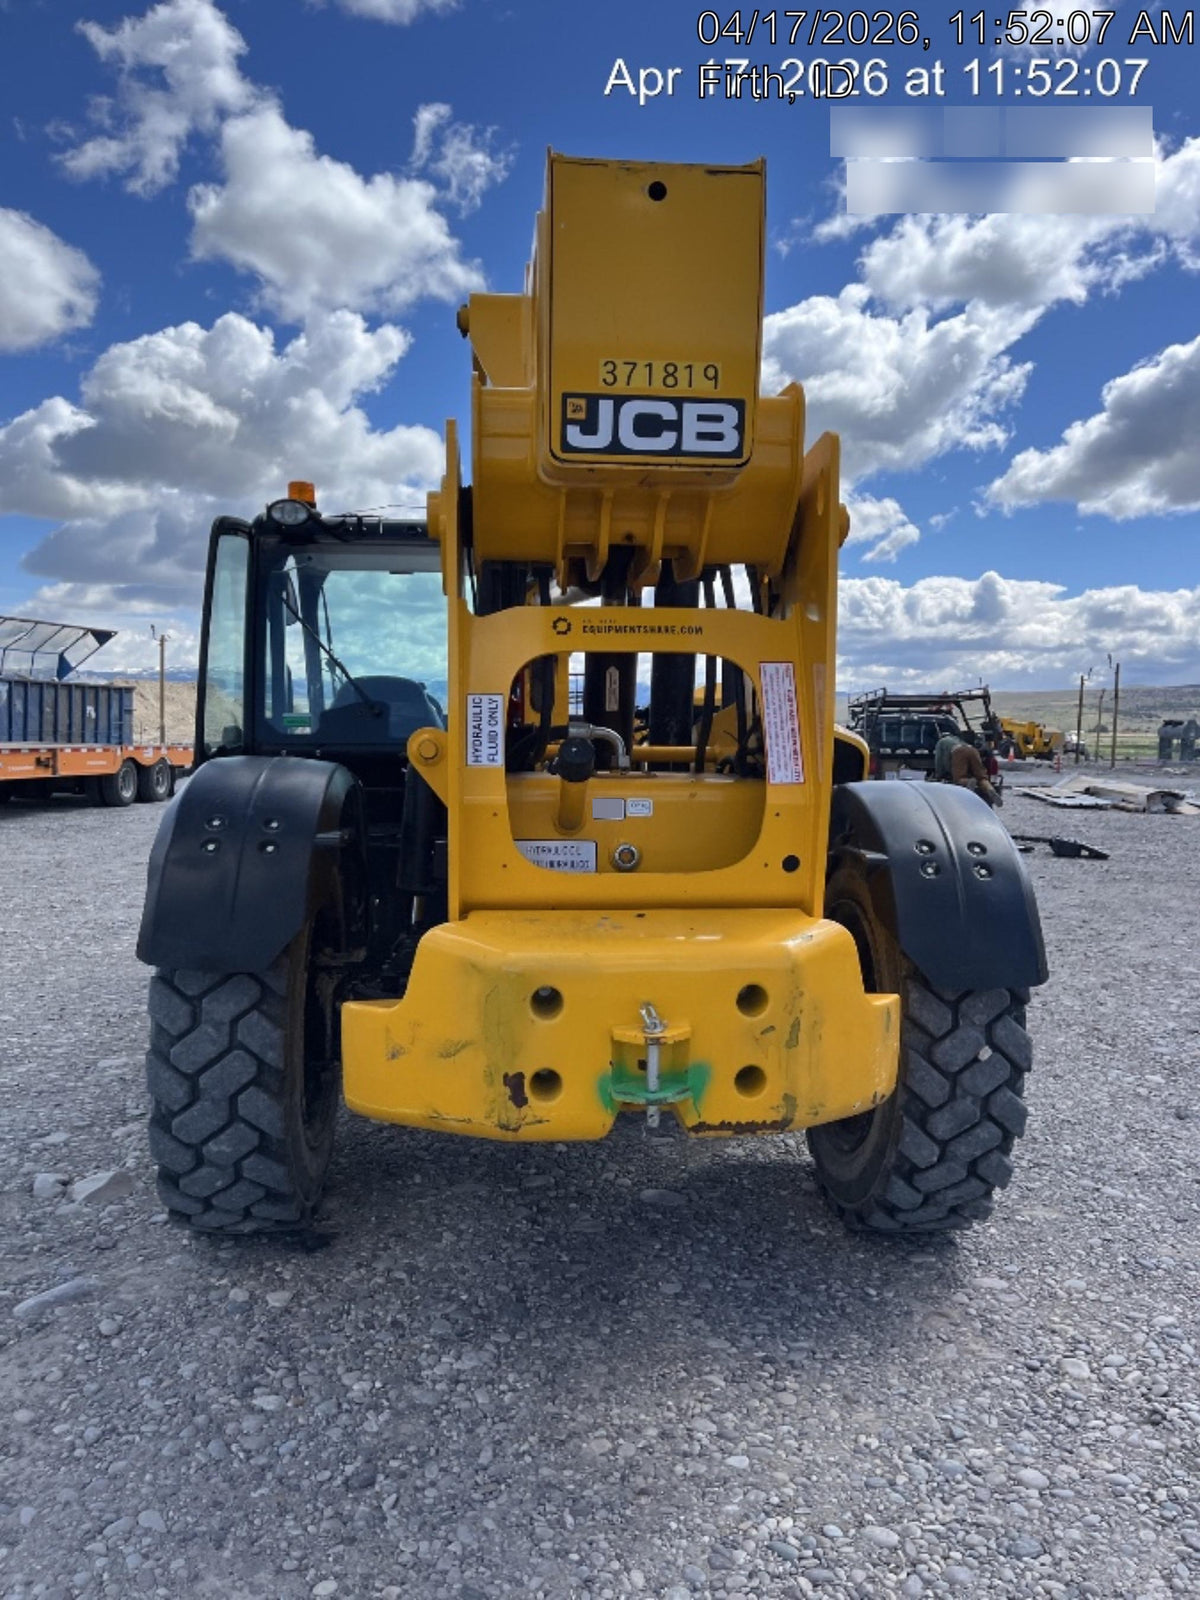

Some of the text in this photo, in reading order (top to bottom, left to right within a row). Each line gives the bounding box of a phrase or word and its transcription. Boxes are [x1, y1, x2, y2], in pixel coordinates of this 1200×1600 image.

[602, 360, 720, 390] 371819
[566, 399, 741, 452] JCB
[582, 625, 703, 635] EQUIPMENTSHARE.COM
[472, 696, 482, 763] HYDRAULIC
[487, 697, 498, 763] FLUID ONLY
